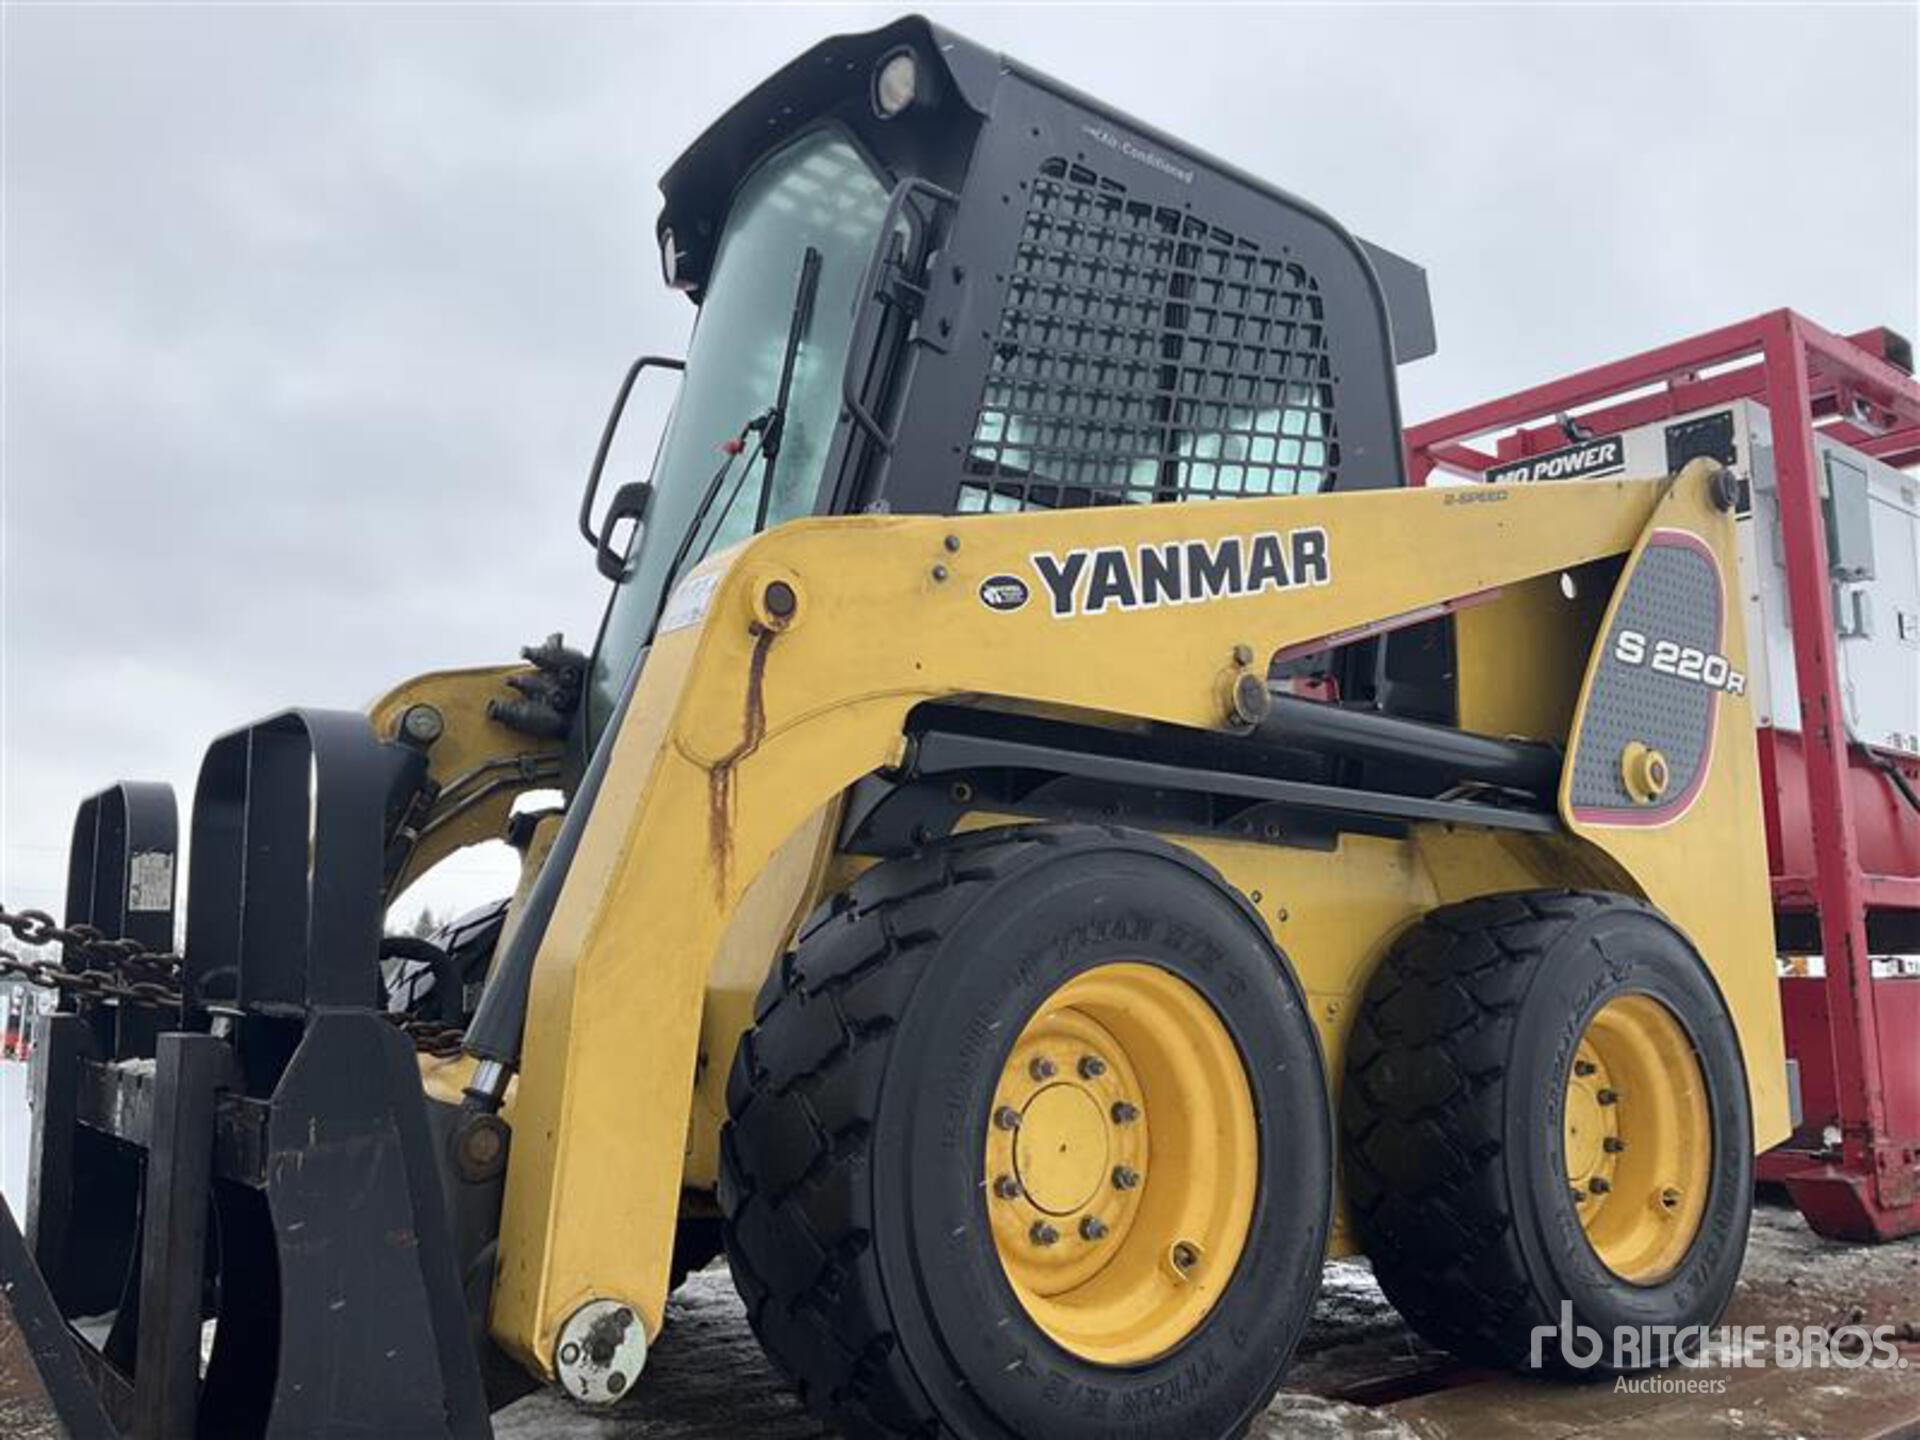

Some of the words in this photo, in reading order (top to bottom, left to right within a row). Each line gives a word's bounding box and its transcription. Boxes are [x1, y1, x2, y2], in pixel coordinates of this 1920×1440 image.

[1533, 443, 1616, 484] POWER
[1034, 527, 1330, 617] YANMAR
[1614, 629, 1647, 665] S
